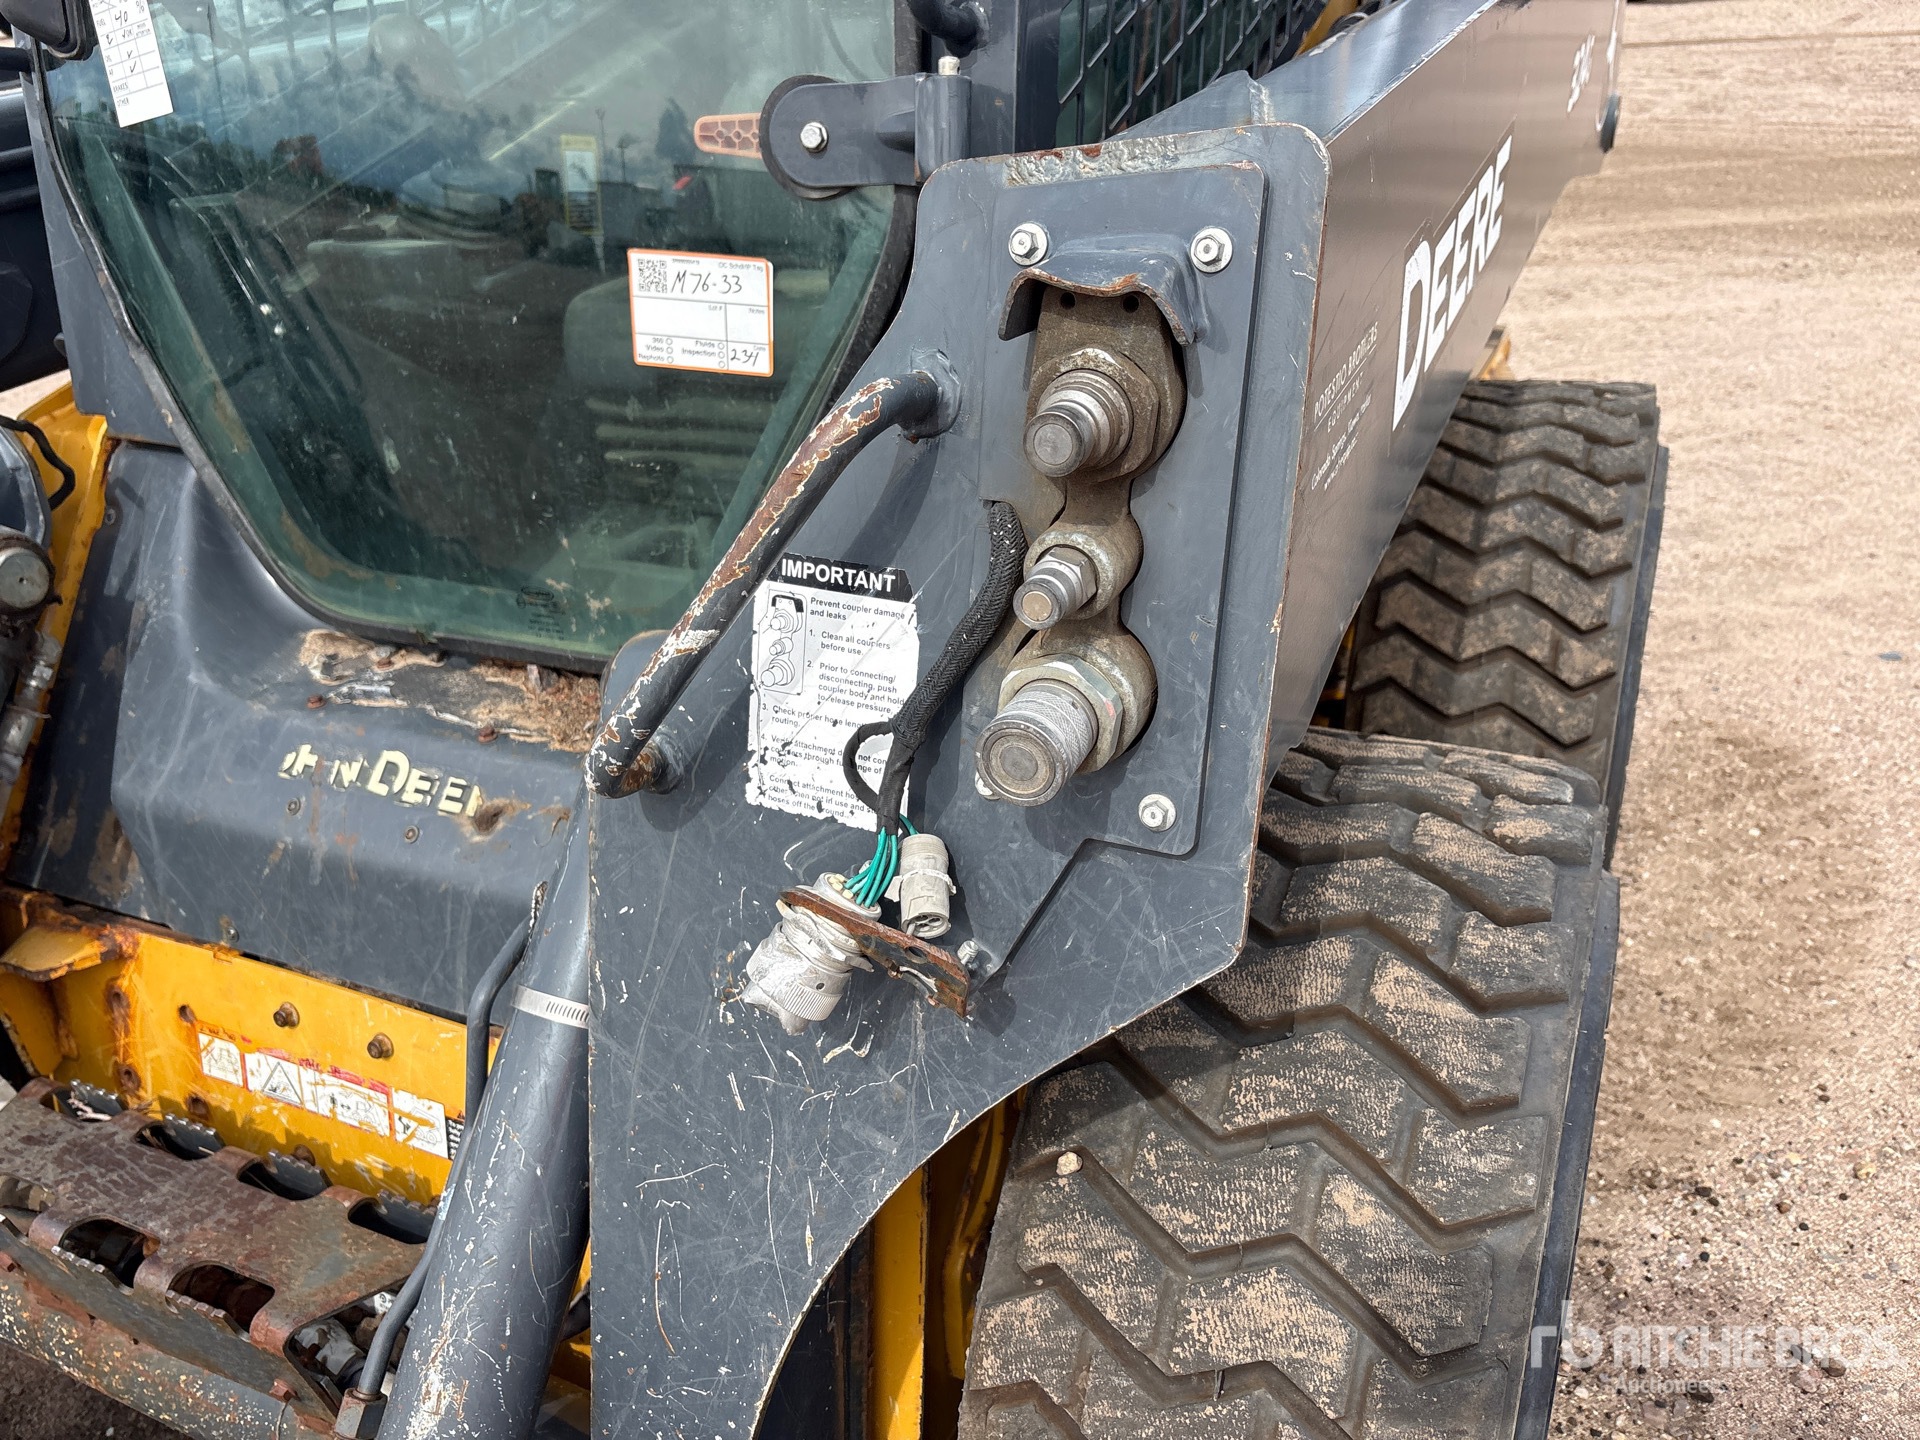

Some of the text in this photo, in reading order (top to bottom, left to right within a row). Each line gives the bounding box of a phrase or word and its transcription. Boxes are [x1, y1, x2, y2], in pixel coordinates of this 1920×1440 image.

[1392, 134, 1513, 433] DEERE
[645, 344, 664, 353] Video
[681, 348, 717, 358] Inspection
[781, 558, 897, 593] IMPORTANT
[809, 609, 847, 621] and leaks
[810, 597, 906, 621] Prevent coupler damage
[809, 629, 891, 650] 1. Clean all couplers
[820, 641, 864, 656] before use.
[807, 660, 897, 684] 2. Prior to connecting/
[818, 673, 897, 694] disconnecting, push
[817, 693, 826, 701] to
[826, 694, 855, 707] elease
[818, 684, 847, 695] coupler
[849, 689, 869, 701] body
[887, 695, 905, 706] hold
[762, 703, 769, 711] 3.
[772, 704, 796, 717] Check
[824, 715, 843, 727] hoe
[771, 716, 801, 728] routing.
[793, 740, 836, 756] attachment
[858, 754, 871, 762] not
[803, 752, 835, 766] through
[769, 774, 800, 788] Connct
[801, 782, 844, 798] attachment
[767, 794, 790, 805] hoses
[792, 799, 803, 808] off
[803, 802, 816, 811] the
[834, 799, 849, 809] use
[850, 803, 865, 812] and
